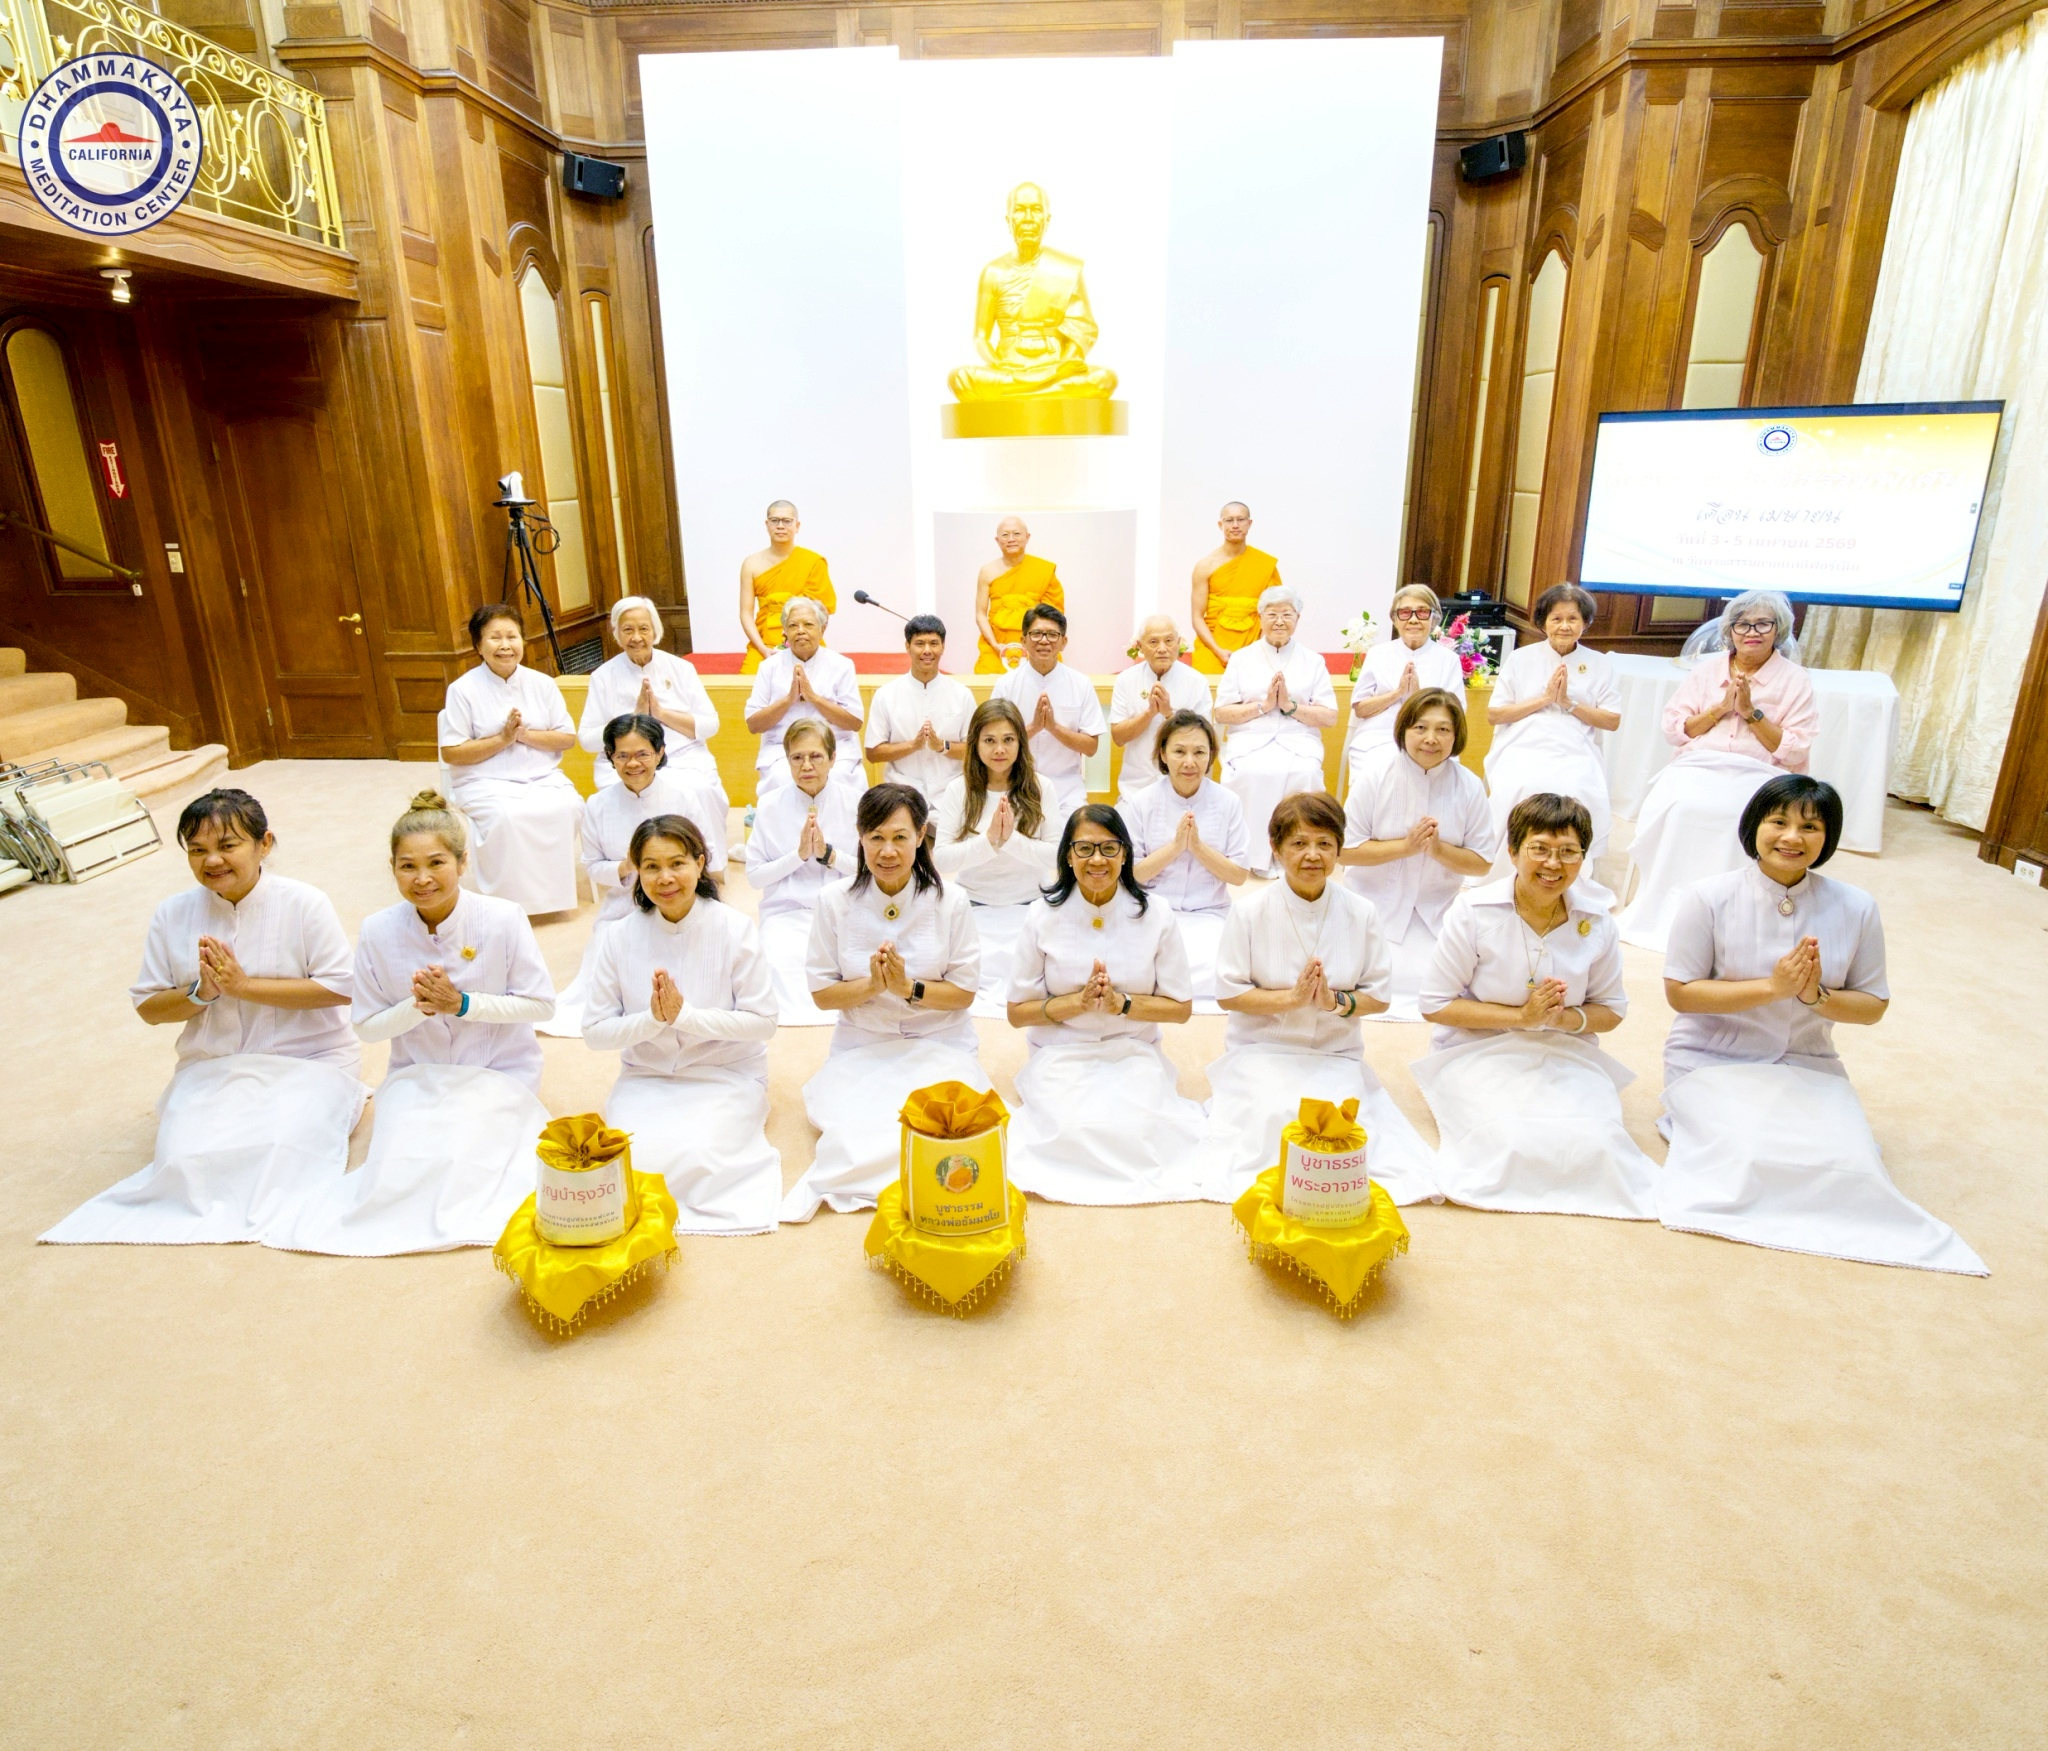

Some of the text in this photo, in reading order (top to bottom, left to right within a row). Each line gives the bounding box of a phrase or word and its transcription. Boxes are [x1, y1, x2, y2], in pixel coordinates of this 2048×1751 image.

[1710, 535, 1720, 545] 3
[1734, 535, 1743, 546] 5
[1814, 537, 1857, 550] 2569
[935, 1202, 983, 1216] บูชาธรรม
